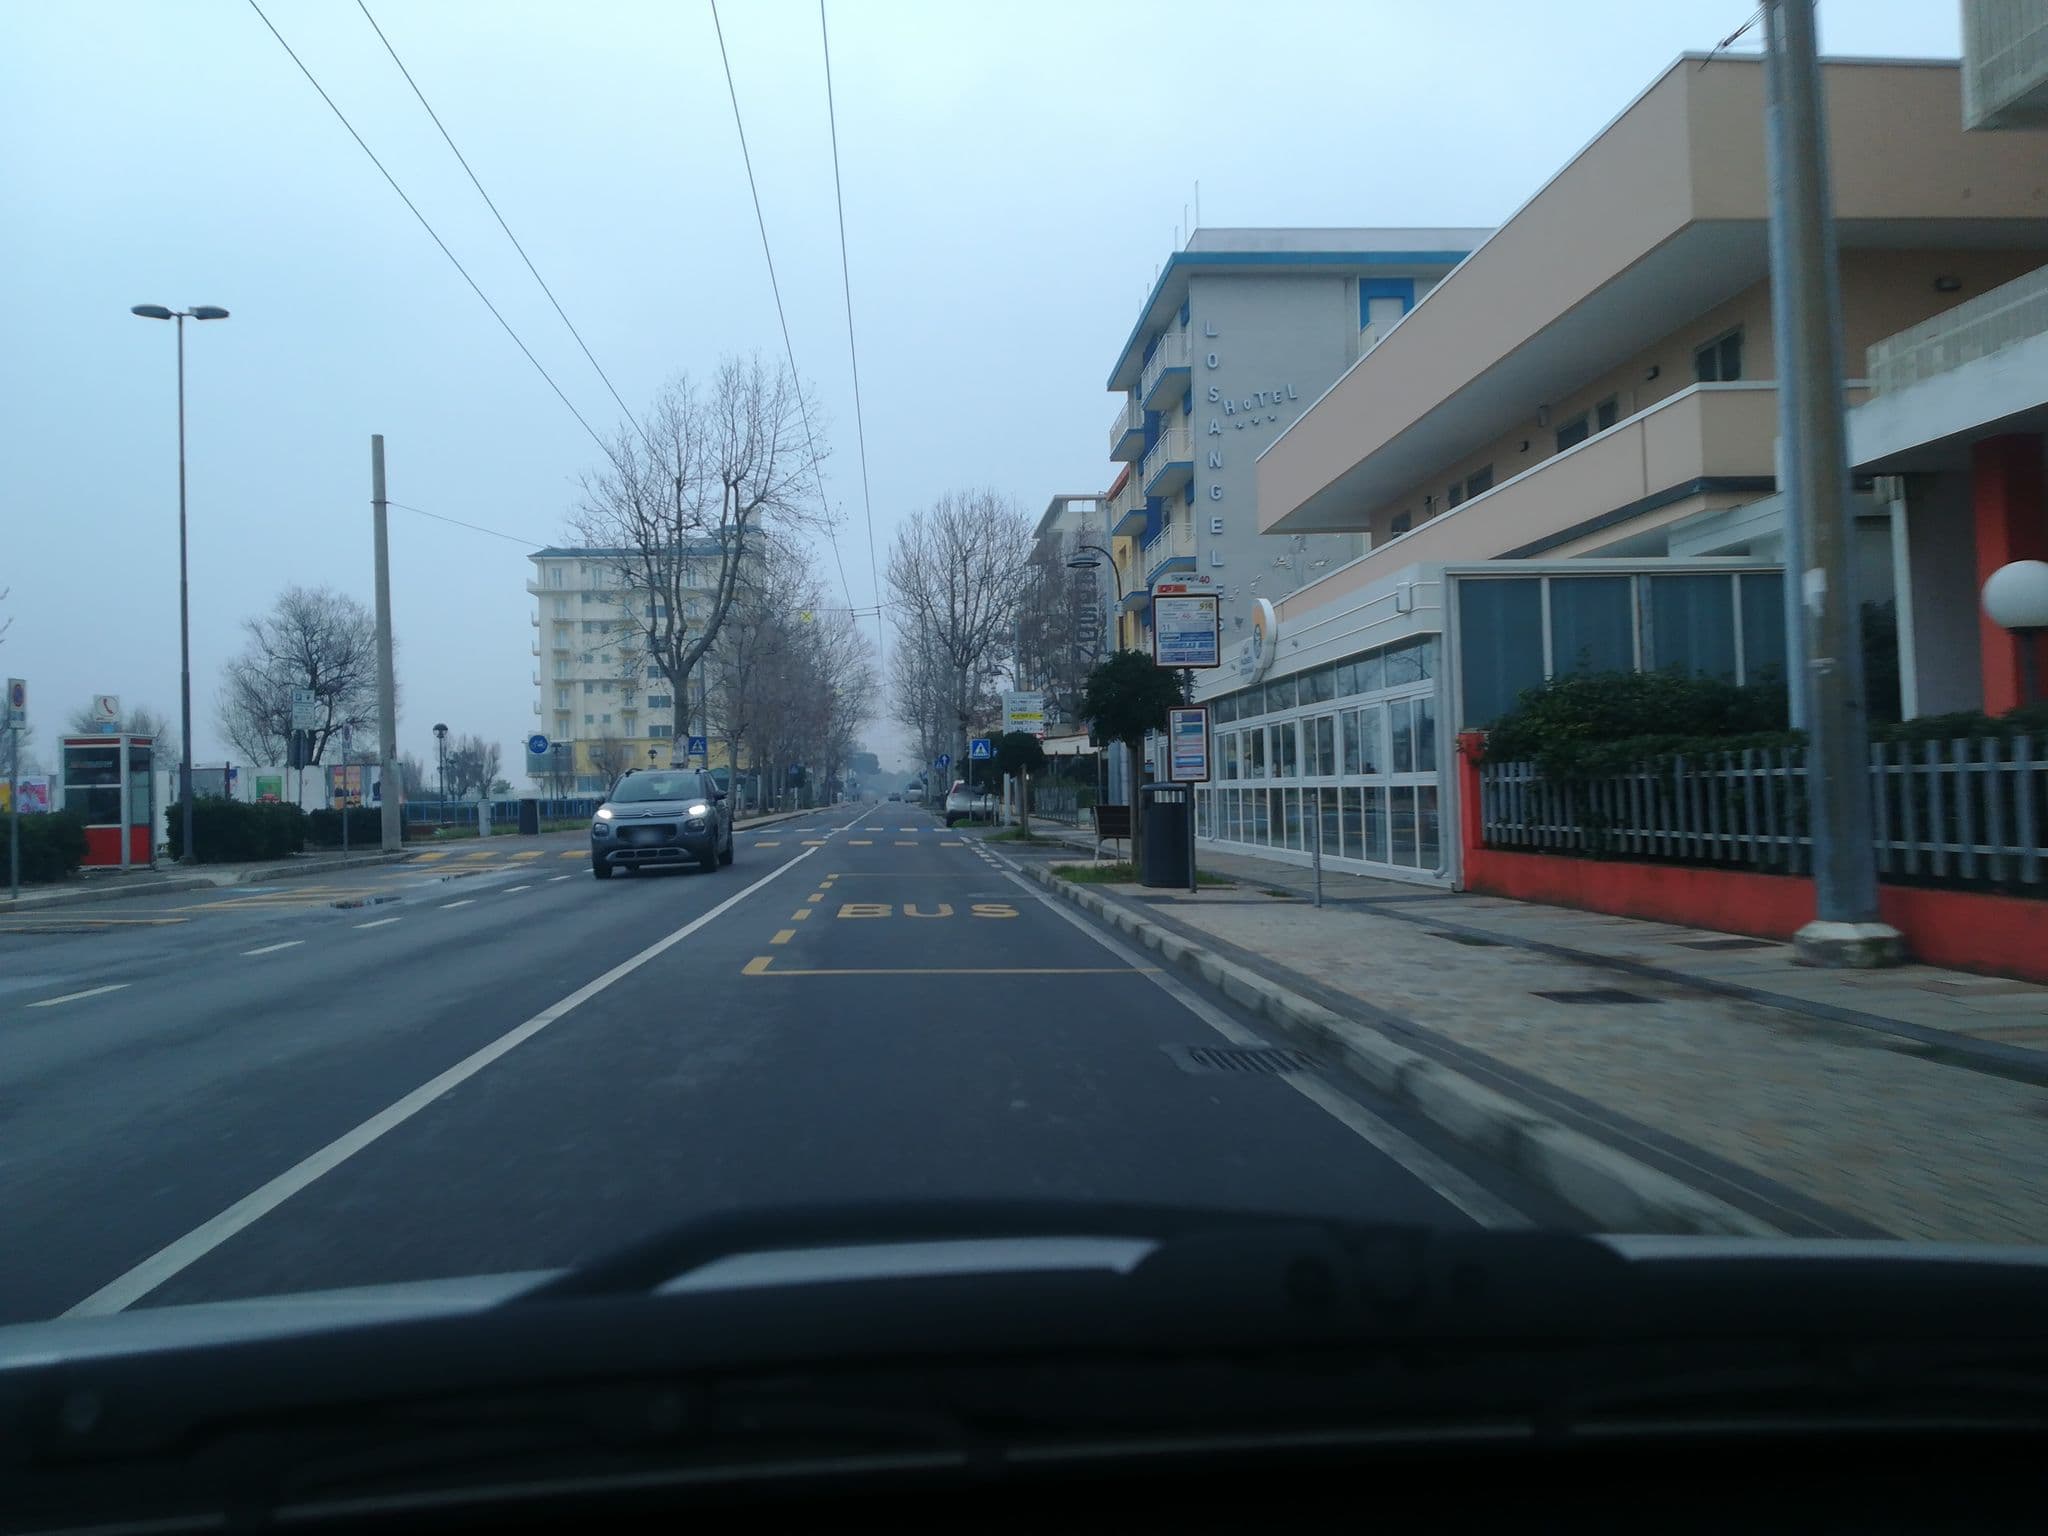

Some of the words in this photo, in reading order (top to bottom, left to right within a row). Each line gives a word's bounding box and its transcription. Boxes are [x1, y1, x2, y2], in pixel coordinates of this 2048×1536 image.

[1205, 319, 1220, 403] LOS
[1223, 383, 1298, 417] HOTEL
[1199, 575, 1211, 584] 40
[836, 902, 1020, 919] BUS
